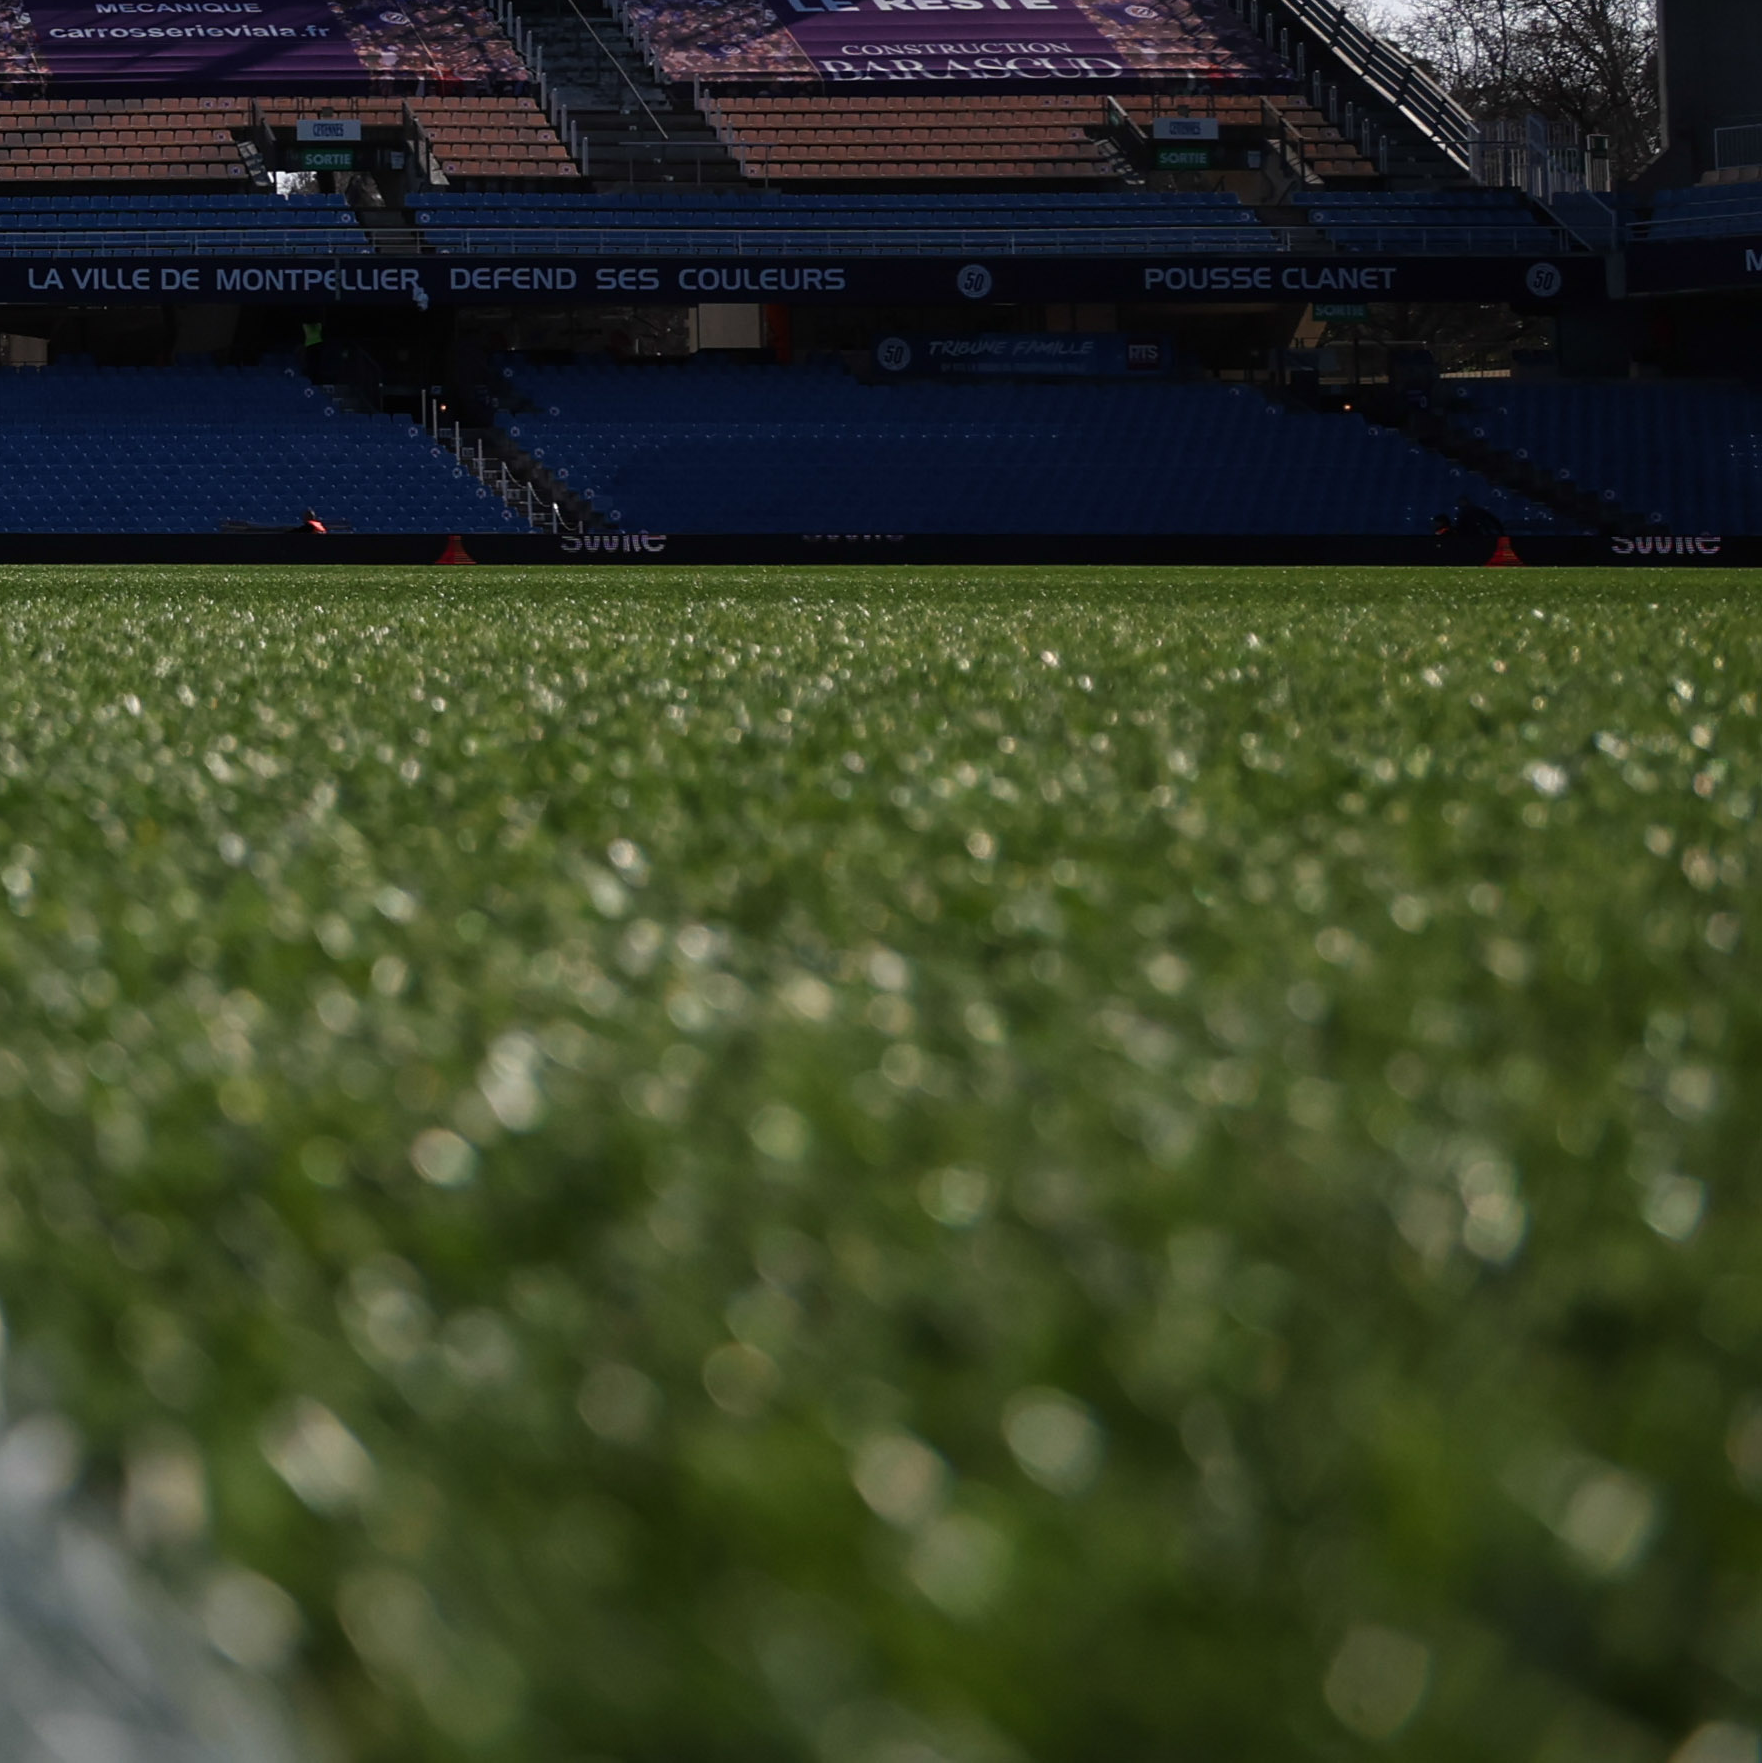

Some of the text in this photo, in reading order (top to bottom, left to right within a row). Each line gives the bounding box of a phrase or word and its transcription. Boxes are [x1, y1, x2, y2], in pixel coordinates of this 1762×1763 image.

[95, 2, 264, 15] MECANIQUE
[49, 24, 331, 39] carrosserieviala.fr
[841, 42, 1073, 57] CONSTRUCTION
[818, 57, 1124, 81] BARASCUD
[305, 153, 352, 165] SORTIE
[1159, 152, 1207, 164] SORTIE
[27, 267, 846, 291] LA VILLE DE MONTPELLIER DEFEND SES COULEURS
[1144, 266, 1397, 290] POUSSE CLANET
[1315, 304, 1363, 317] SORTIE
[928, 339, 1094, 357] TRIBUNE FAMILLE
